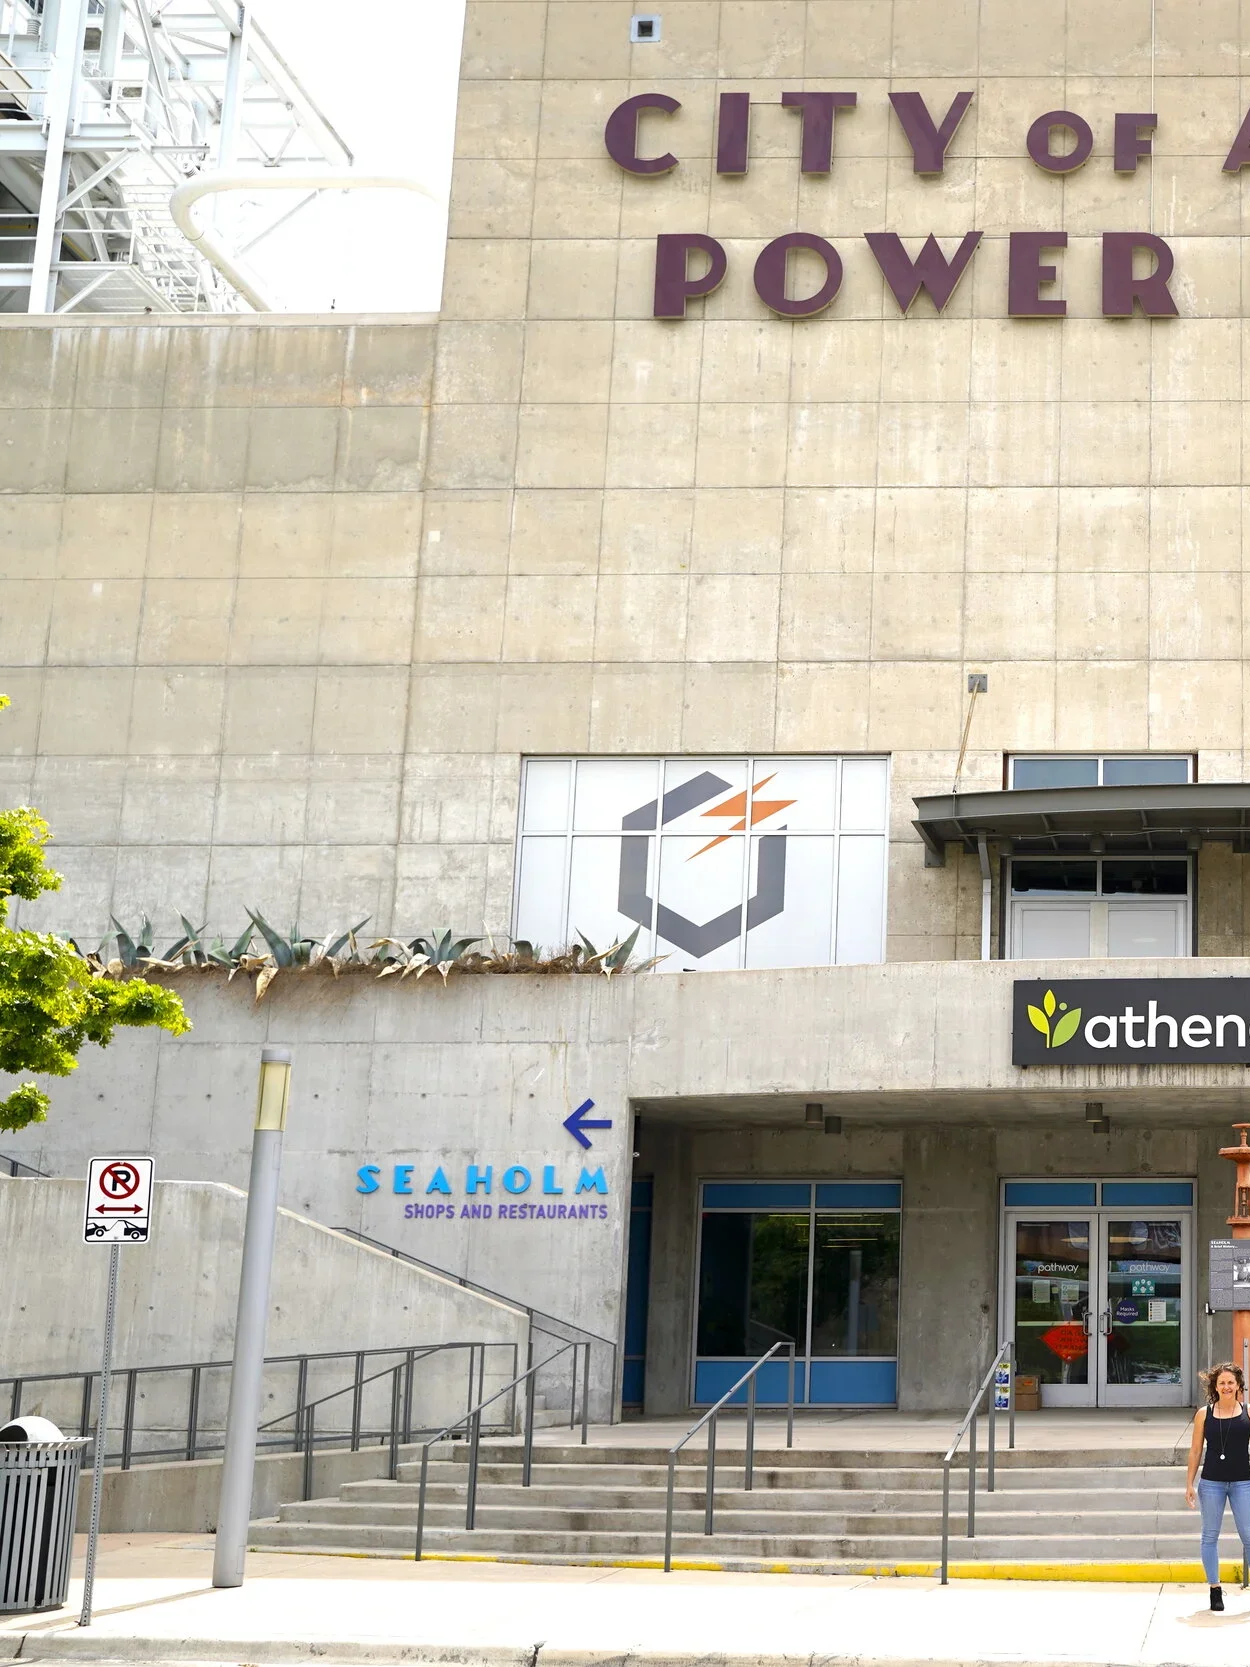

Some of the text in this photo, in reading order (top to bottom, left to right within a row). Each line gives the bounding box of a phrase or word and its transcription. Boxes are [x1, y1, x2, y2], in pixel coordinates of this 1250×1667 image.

[604, 91, 974, 176] CITY
[1026, 110, 1158, 174] OF
[653, 231, 1180, 318] POWER
[356, 1165, 609, 1195] SEAHOLM
[404, 1204, 609, 1219] SHOPS AND RESTAURANTS
[1037, 1262, 1079, 1274] pathway
[1129, 1262, 1170, 1273] pathway
